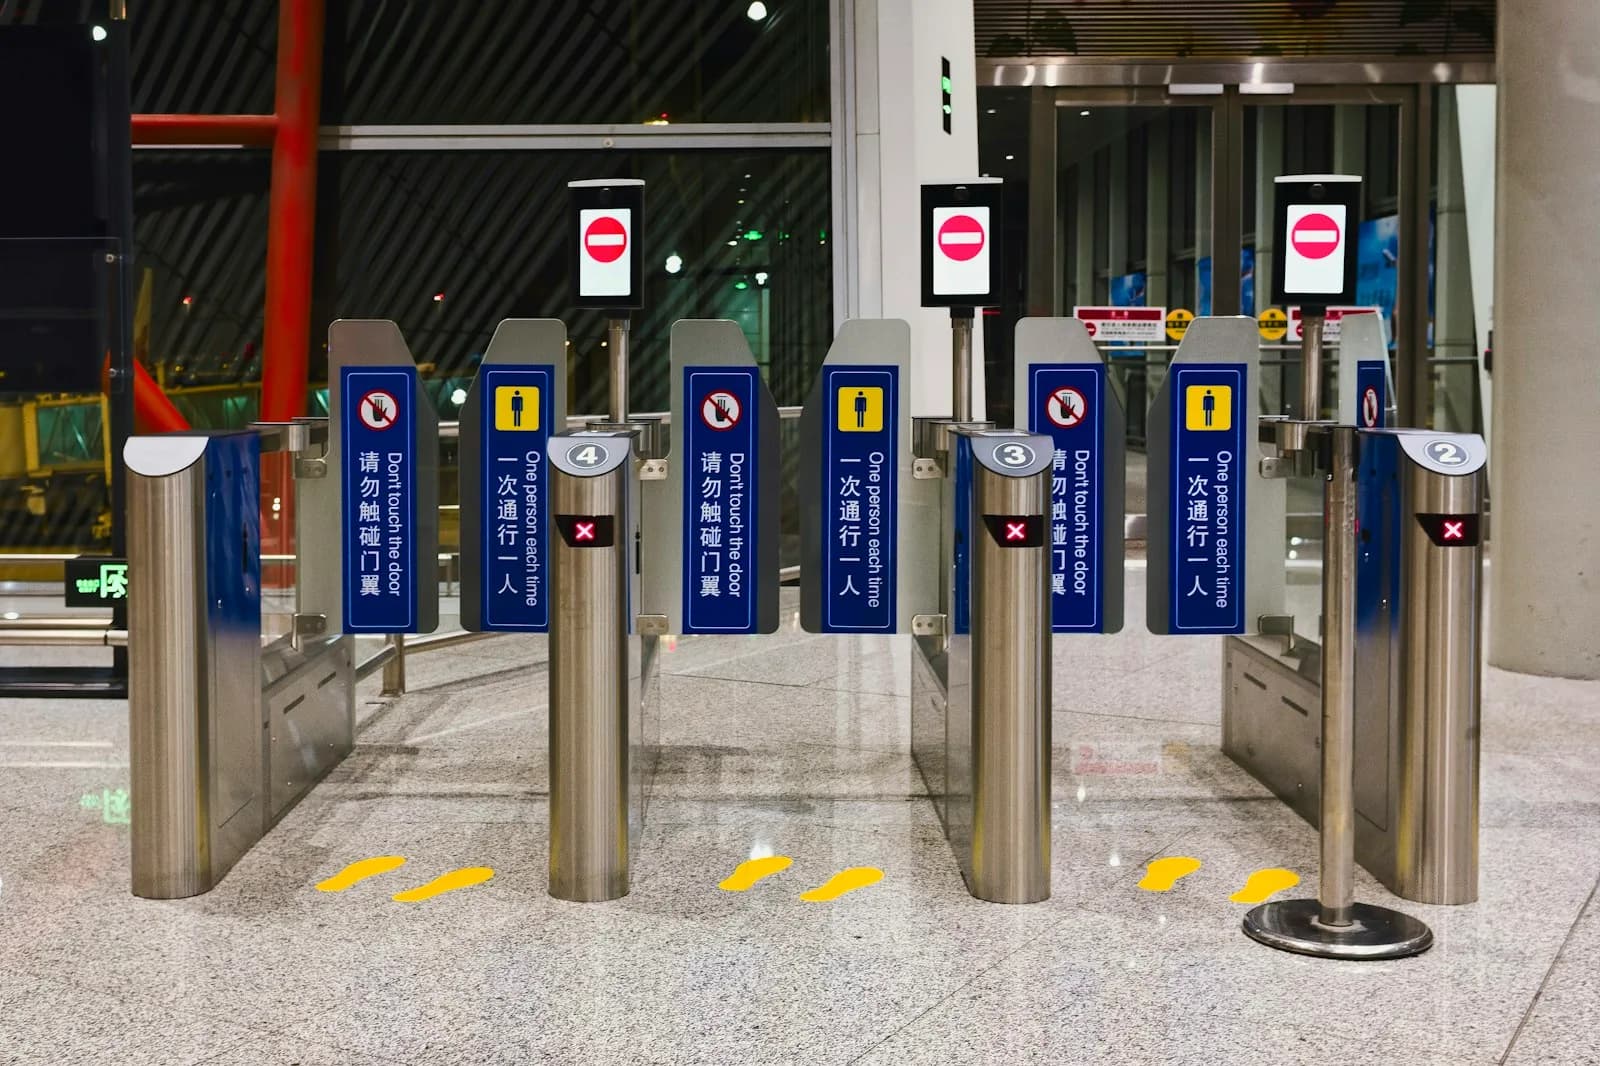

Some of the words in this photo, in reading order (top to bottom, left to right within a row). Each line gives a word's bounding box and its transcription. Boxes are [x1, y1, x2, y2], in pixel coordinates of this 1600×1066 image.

[526, 451, 540, 481] One
[576, 446, 598, 464] 4
[869, 452, 884, 482] One
[1004, 446, 1026, 464] 3
[1075, 450, 1089, 487] Don't
[1217, 451, 1232, 481] One
[1435, 444, 1460, 462] 2
[388, 453, 402, 490] Don't
[729, 453, 744, 490] Don't
[359, 451, 381, 596] 请勿触碰门翼
[388, 492, 402, 533] touch
[497, 457, 518, 594] 一次通行一人
[523, 485, 538, 534] person
[700, 451, 722, 597] 请勿触碰门翼
[729, 493, 744, 533] touch
[866, 486, 881, 535] person
[1075, 491, 1089, 531] touch
[1214, 485, 1229, 534] person
[839, 458, 861, 596] 一次通行一人
[1187, 457, 1209, 597] 一次通行一人
[389, 536, 402, 559] the
[526, 538, 540, 572] each
[729, 536, 743, 560] the
[869, 539, 883, 573] each
[1074, 535, 1089, 558] the
[1216, 538, 1231, 573] each
[388, 563, 402, 596] door
[526, 576, 540, 606] time
[729, 564, 743, 597] door
[868, 577, 883, 607] time
[1074, 561, 1089, 595] door
[1216, 577, 1231, 608] time
